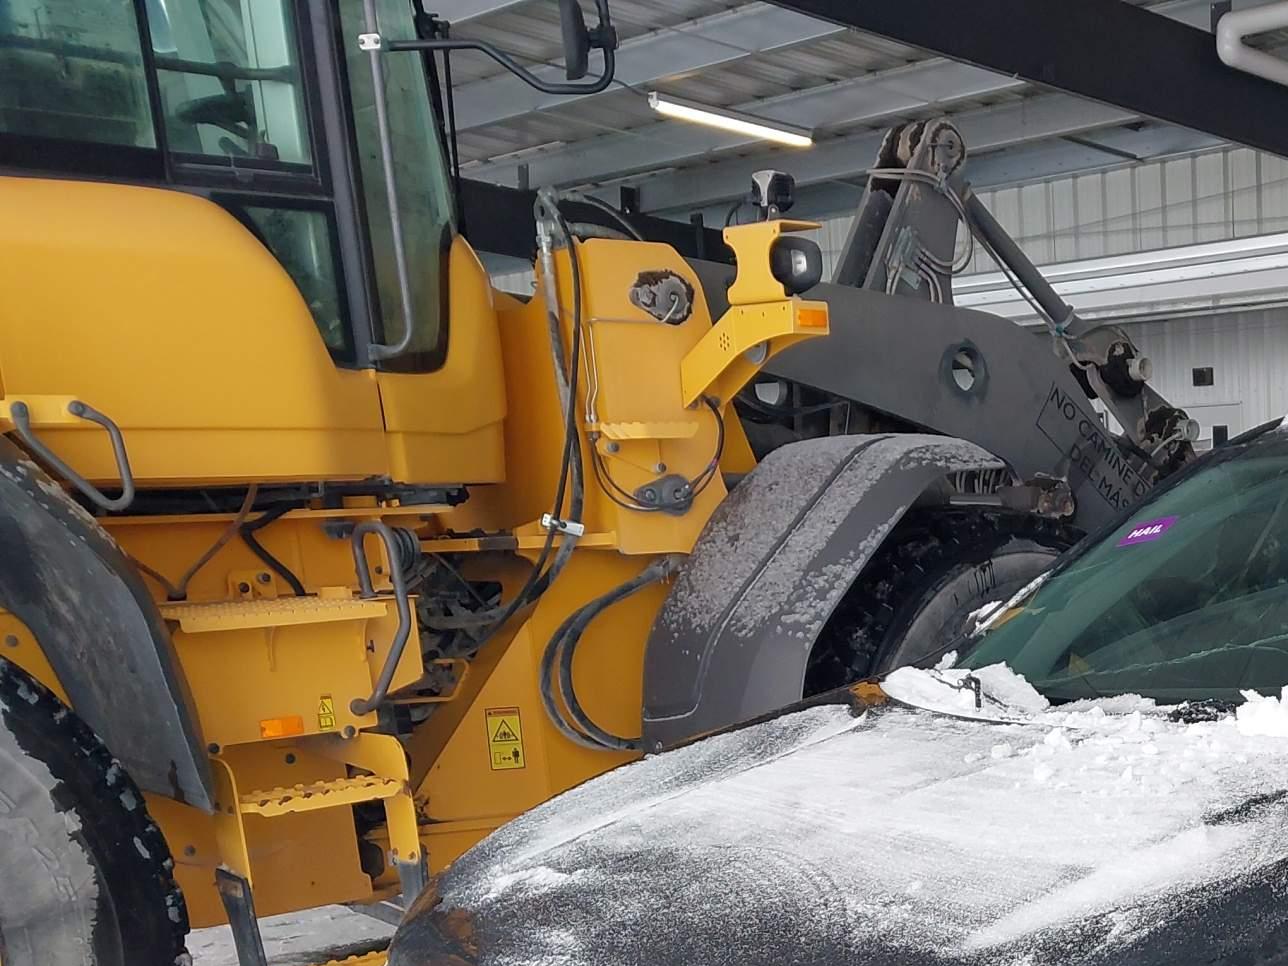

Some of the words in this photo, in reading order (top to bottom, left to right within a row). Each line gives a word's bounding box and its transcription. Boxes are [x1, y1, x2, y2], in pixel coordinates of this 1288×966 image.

[1050, 387, 1076, 420] NO
[1071, 443, 1096, 481] DEL
[1127, 525, 1163, 539] HAIL
